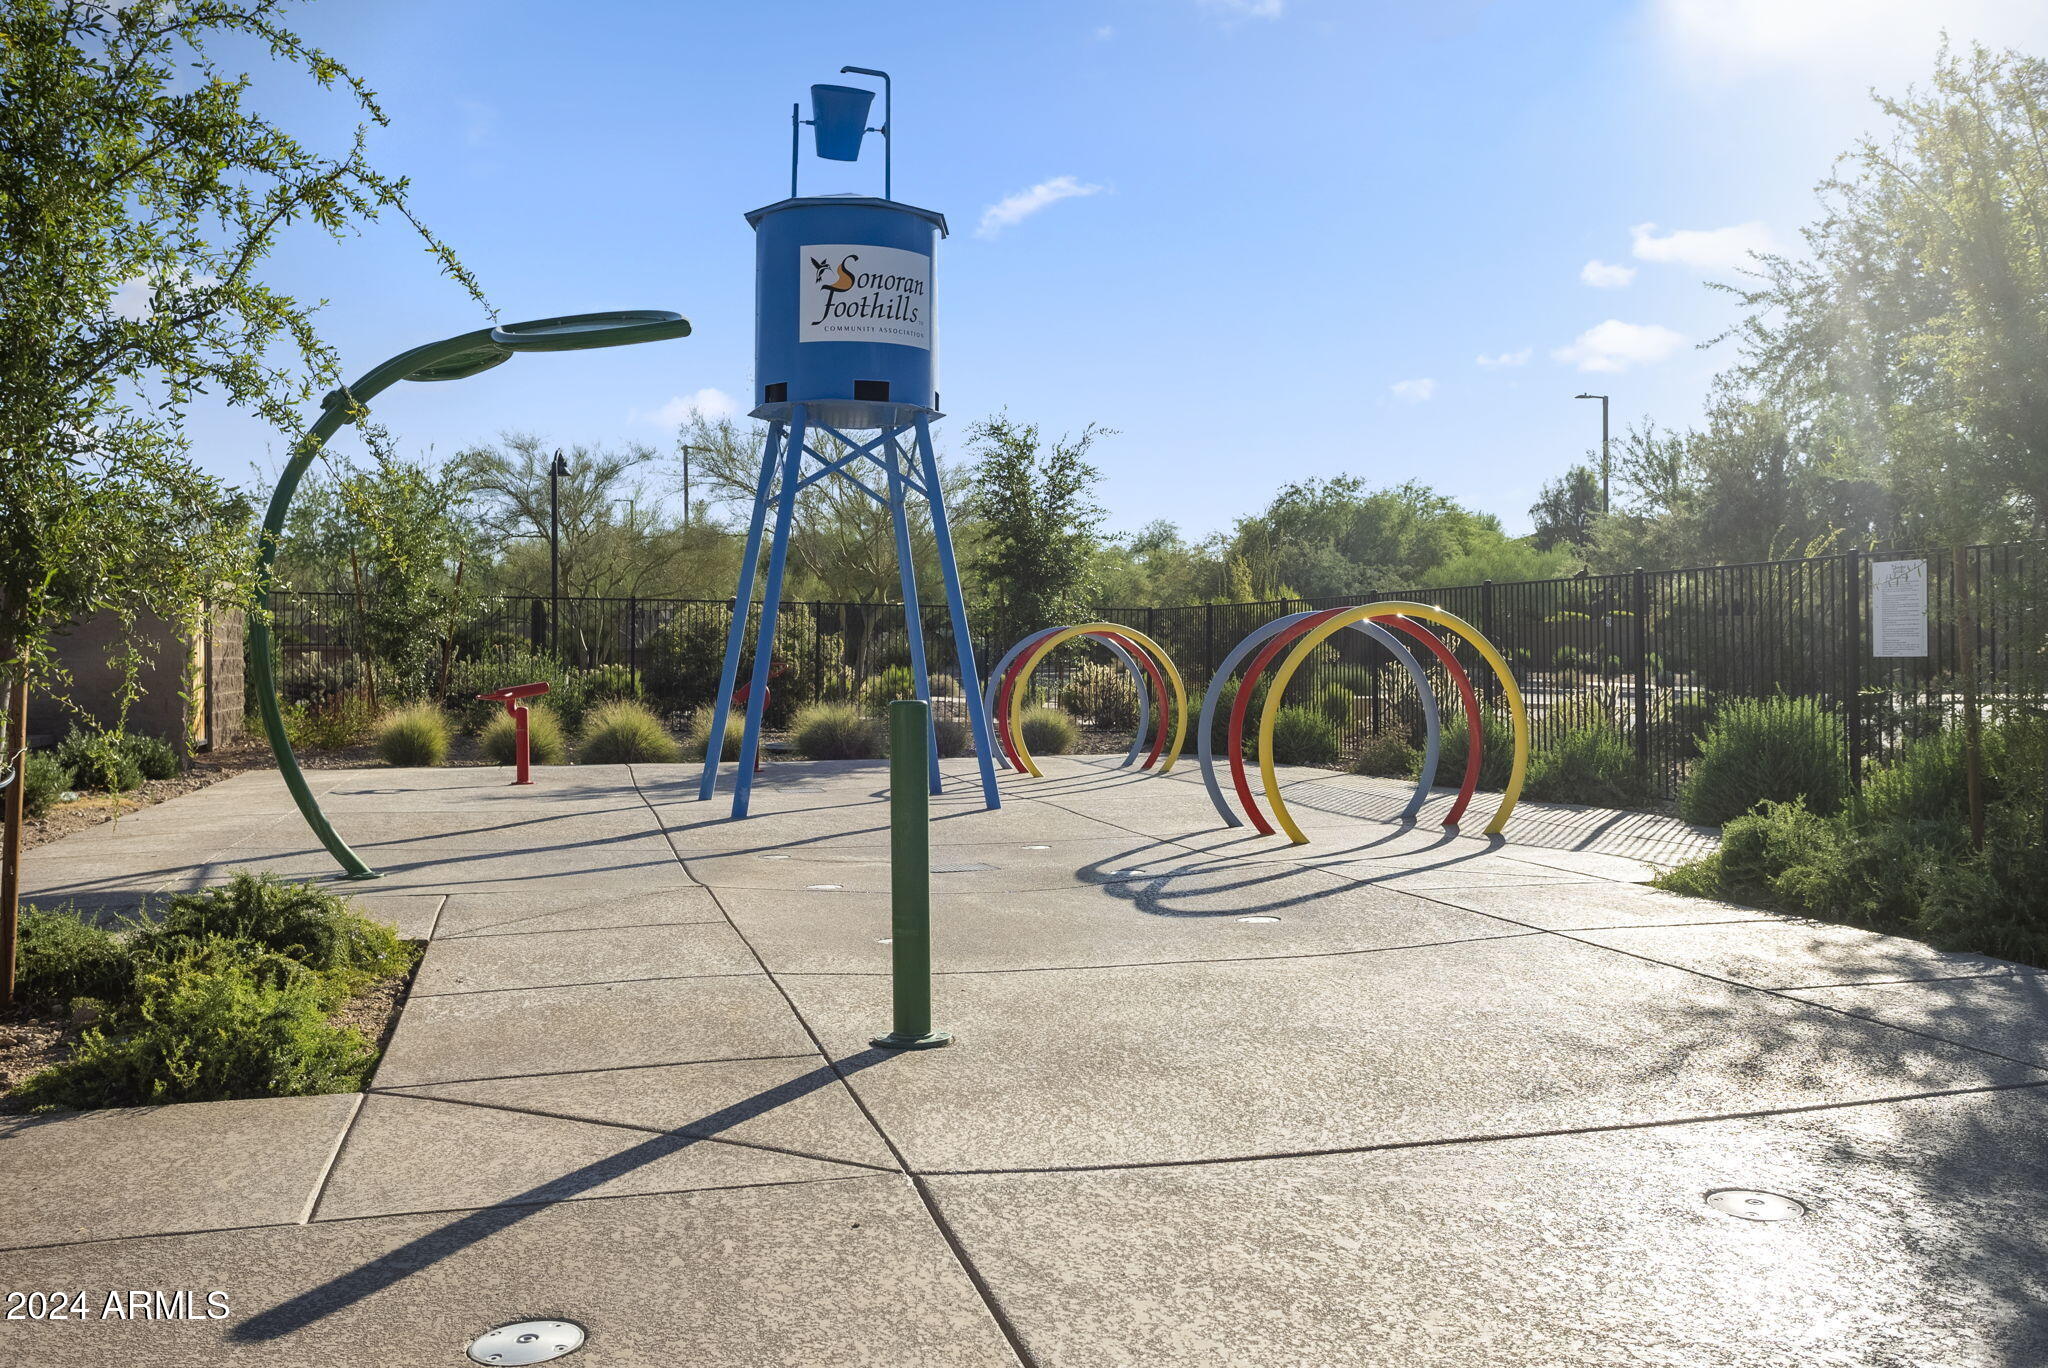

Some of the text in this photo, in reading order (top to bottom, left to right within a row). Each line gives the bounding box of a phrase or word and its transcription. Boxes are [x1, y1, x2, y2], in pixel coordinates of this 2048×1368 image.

[820, 254, 924, 296] Sonoran
[811, 284, 919, 326] Foothills
[824, 325, 924, 338] COMMUNITY ASSOCIATION
